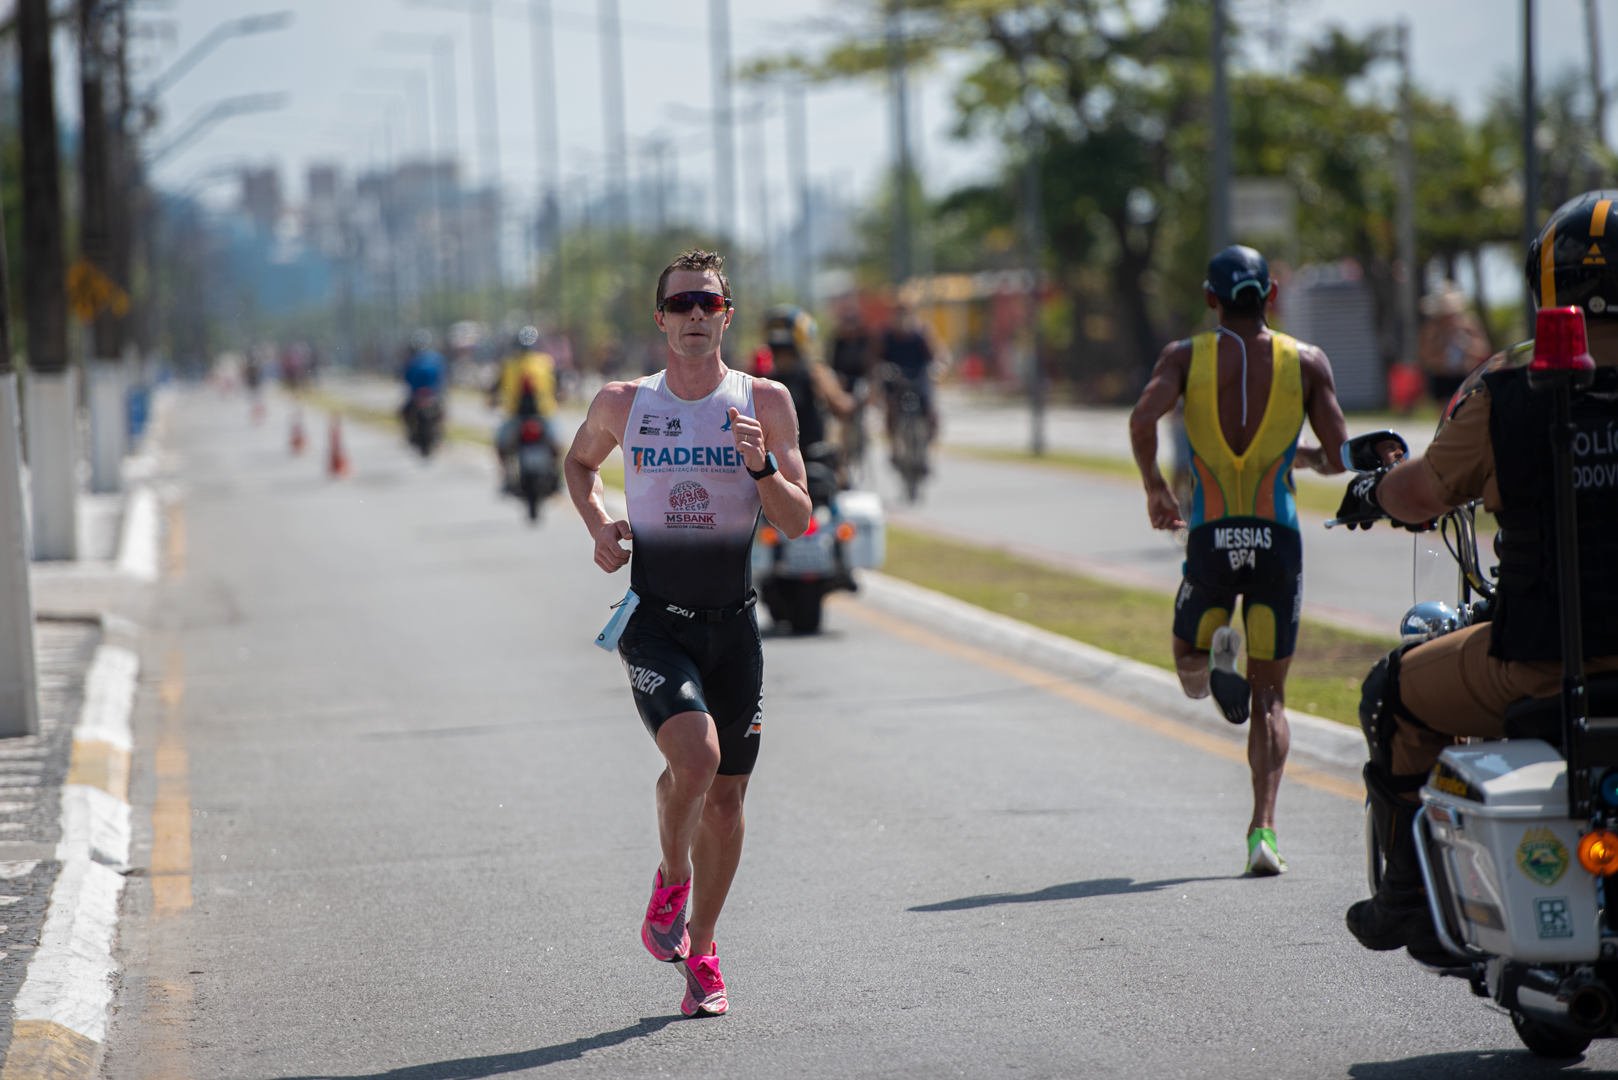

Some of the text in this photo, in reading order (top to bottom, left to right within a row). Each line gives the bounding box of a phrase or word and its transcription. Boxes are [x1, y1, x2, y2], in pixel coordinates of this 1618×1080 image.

[1570, 421, 1618, 456] OLÍ
[643, 466, 699, 474] COMERCIALIZAÇÃO
[1573, 463, 1618, 489] ODOV
[666, 514, 715, 524] MSBANK
[1214, 527, 1272, 550] MESSIAS
